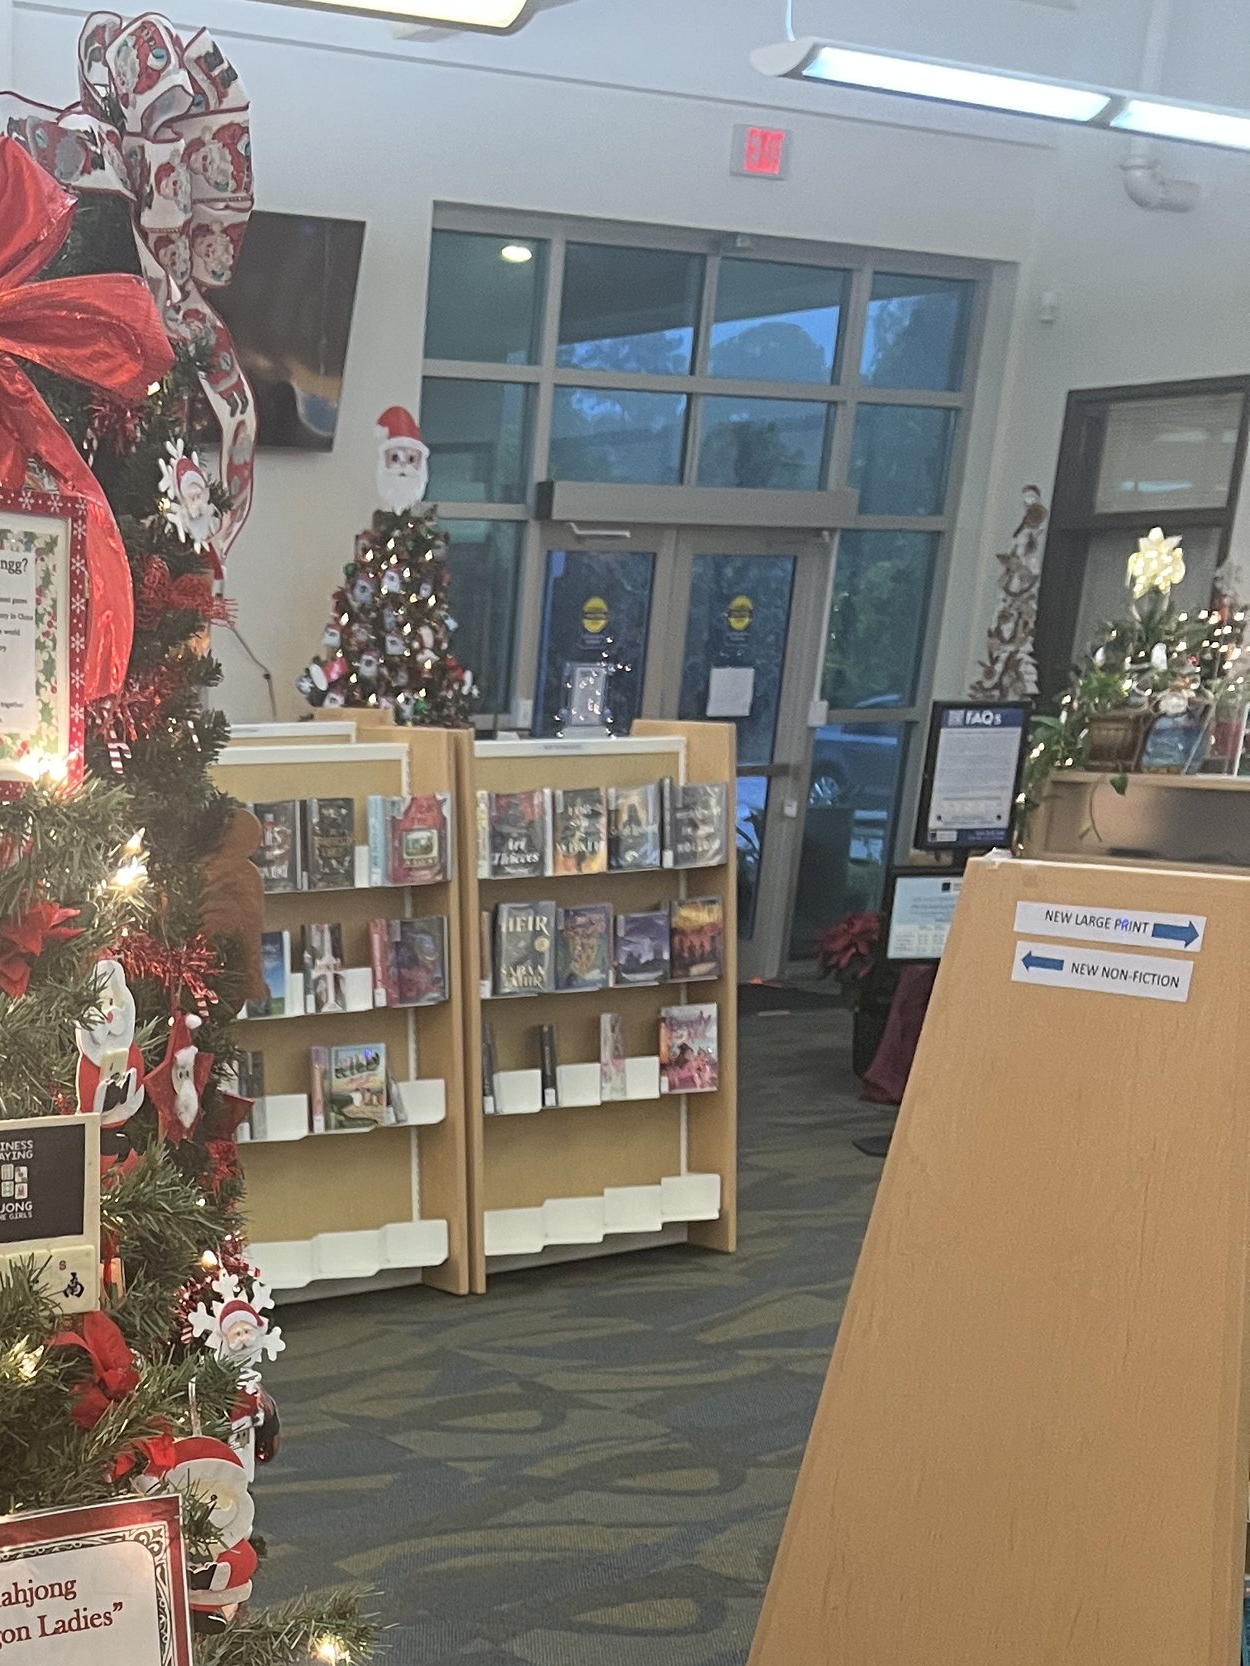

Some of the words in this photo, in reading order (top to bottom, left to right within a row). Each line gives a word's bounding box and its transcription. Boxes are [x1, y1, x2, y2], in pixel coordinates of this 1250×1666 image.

[744, 127, 785, 174] EXIT
[965, 710, 1002, 725] FAQs
[1045, 909, 1072, 924] NEW
[1075, 913, 1111, 929] LARGE
[1114, 918, 1150, 934] PRINT
[1071, 962, 1099, 977] NEW
[1101, 966, 1180, 988] NON-FICTION
[9, 1211, 33, 1221] GIRLS
[59, 1260, 67, 1271] S
[37, 1601, 123, 1637] Ladies”
